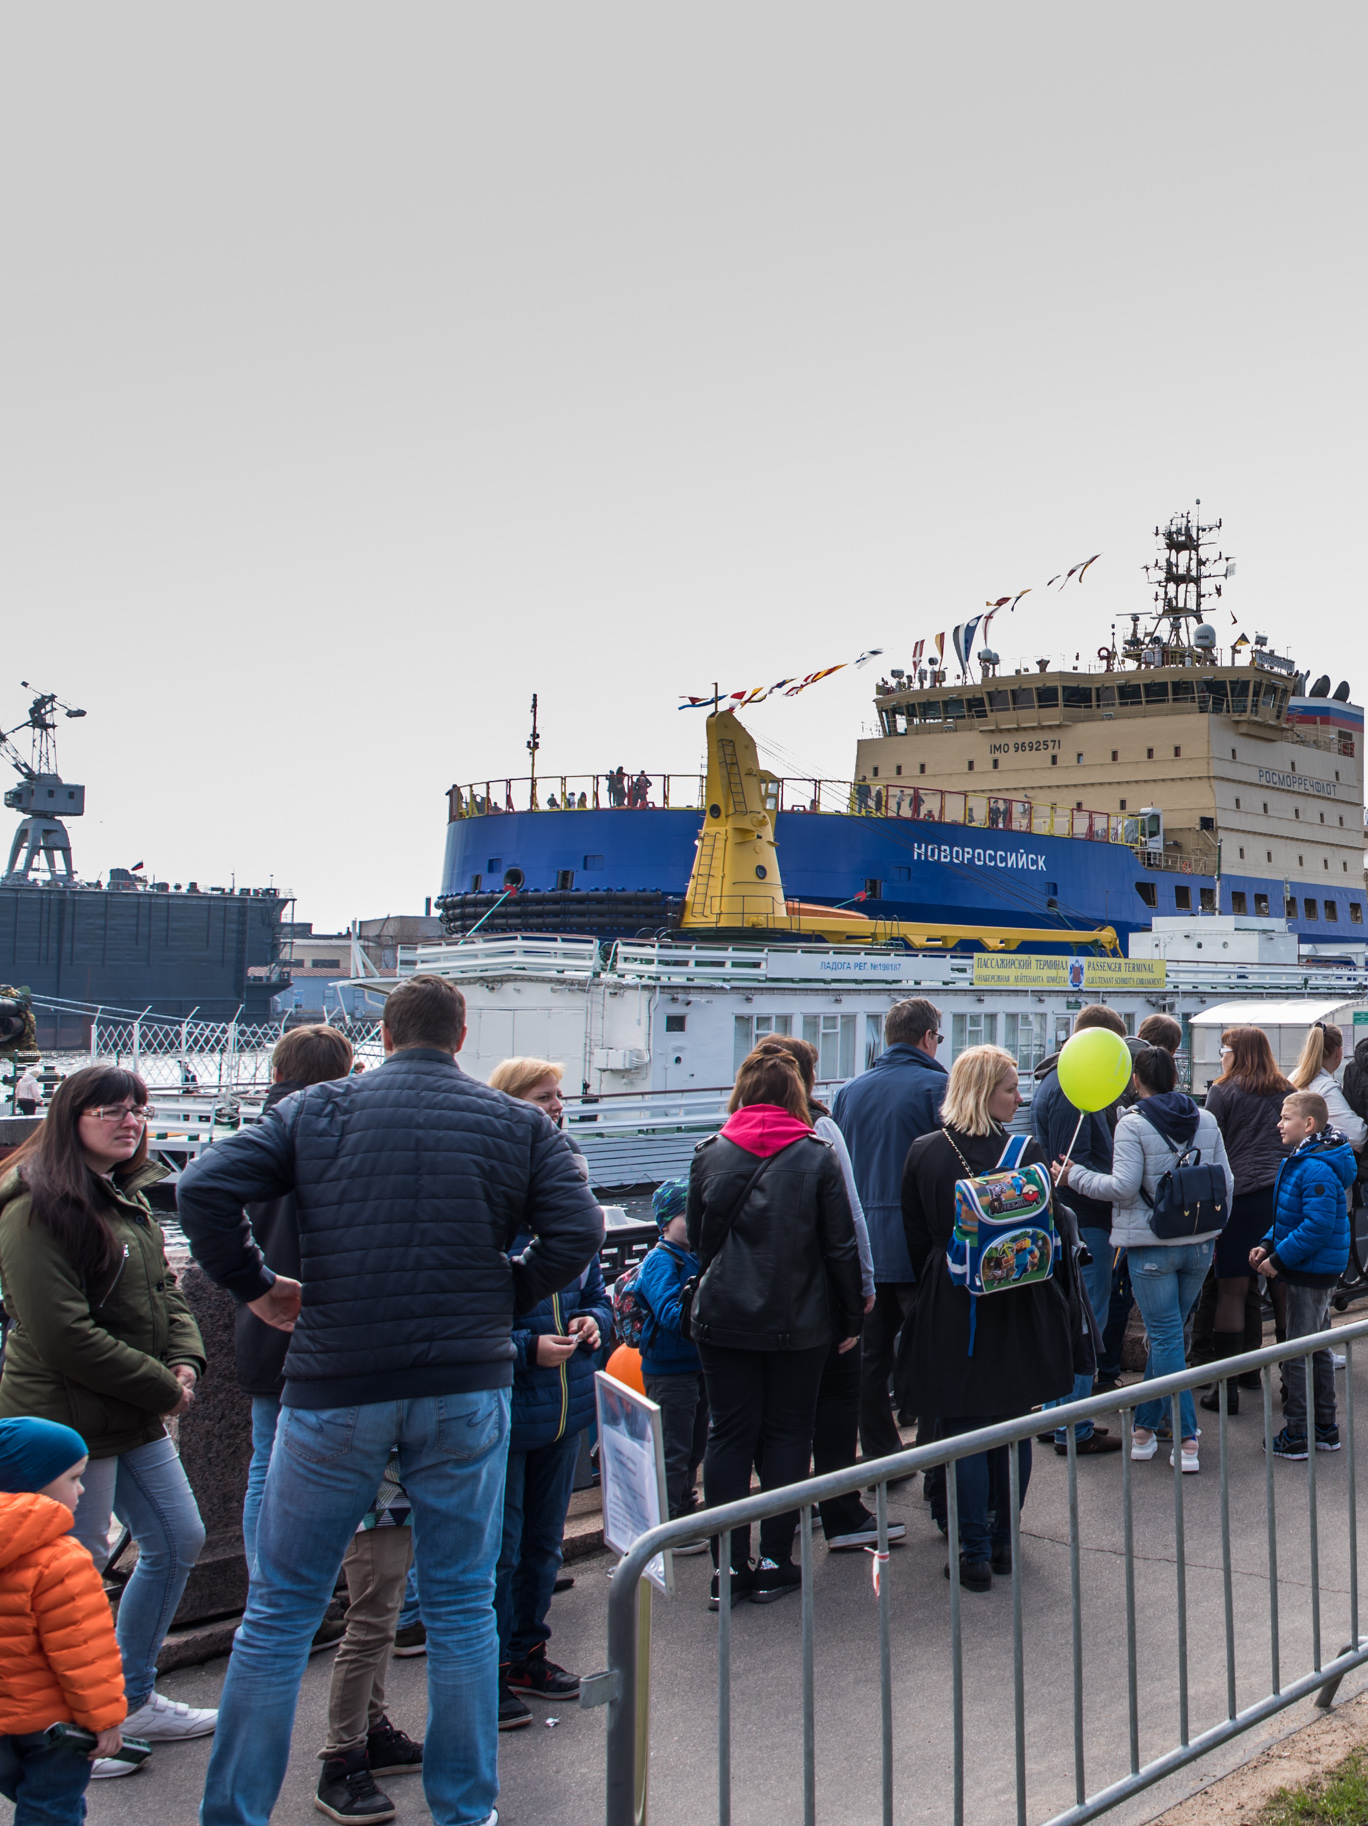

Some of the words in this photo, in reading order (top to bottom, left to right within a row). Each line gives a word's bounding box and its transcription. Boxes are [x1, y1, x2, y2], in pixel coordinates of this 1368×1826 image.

[990, 743, 1010, 754] IMO
[1013, 739, 1061, 753] 9692571
[1258, 769, 1337, 797] РОСМОРРЕЧФЛОТ
[913, 842, 1047, 872] НОВОРОССИЙСК
[820, 961, 851, 971] ЛАДОГА
[853, 962, 869, 971] РЕГ.
[977, 956, 1032, 970] ПАССАЖИРСКИЙ
[1035, 959, 1068, 971] ТЕРМИНАЛ
[1087, 961, 1122, 973] PASSENGER
[1124, 963, 1155, 974] TERMINAL
